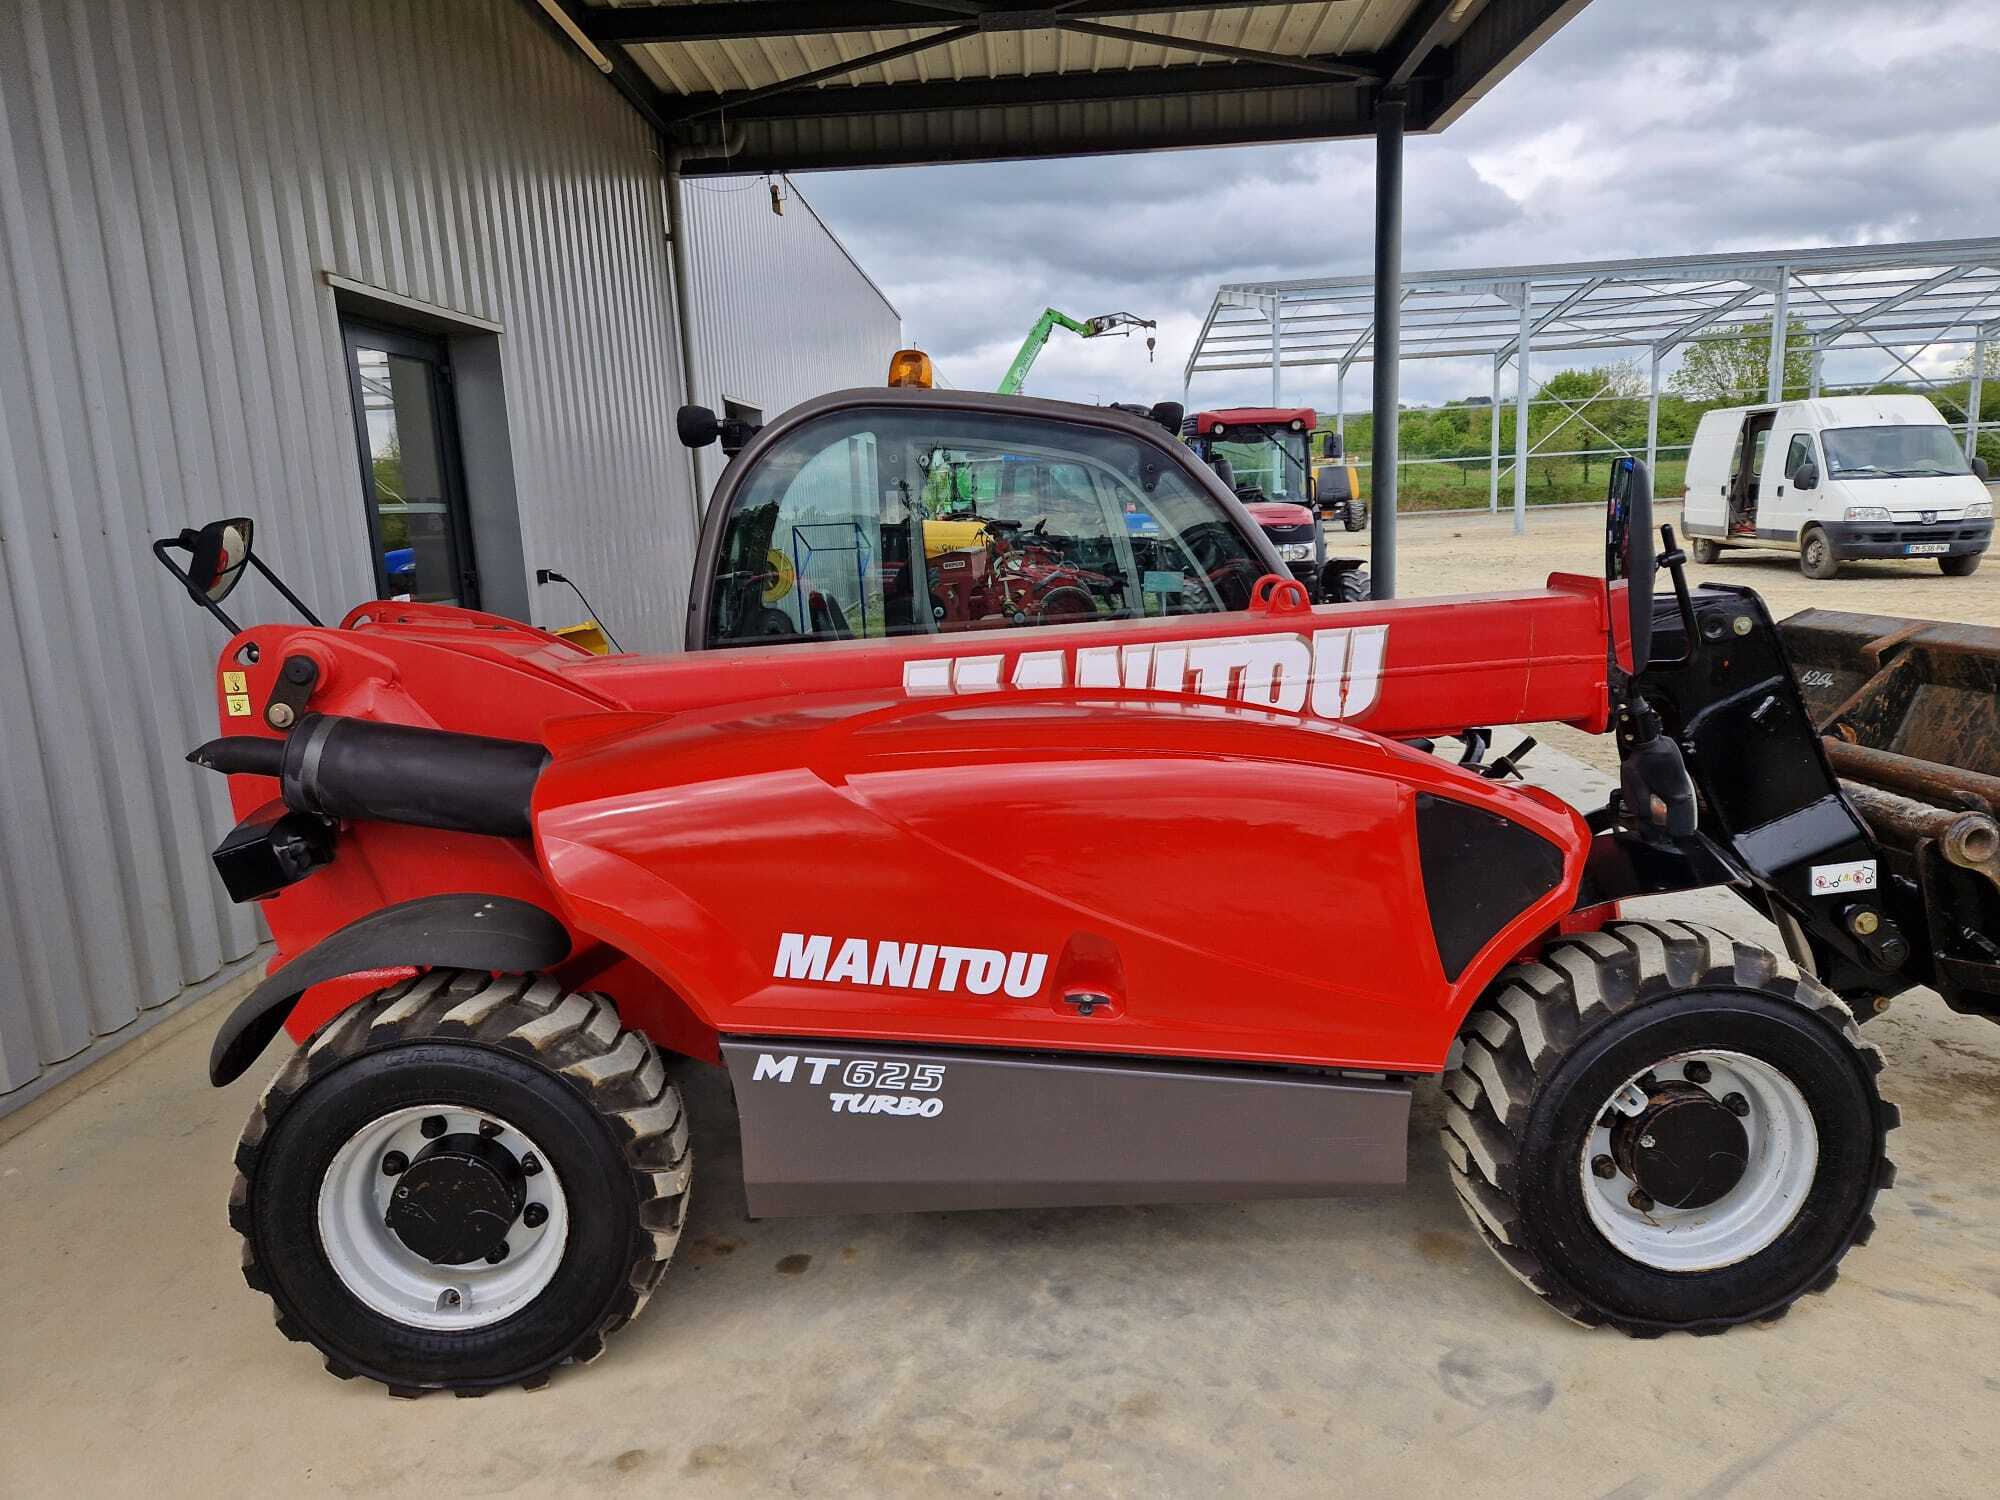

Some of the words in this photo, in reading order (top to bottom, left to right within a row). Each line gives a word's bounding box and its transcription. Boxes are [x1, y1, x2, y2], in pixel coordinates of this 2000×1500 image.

[773, 932, 1048, 998] MANITOU
[753, 1054, 841, 1085] MT
[842, 1060, 946, 1092] 625
[830, 1093, 944, 1118] TURBO
